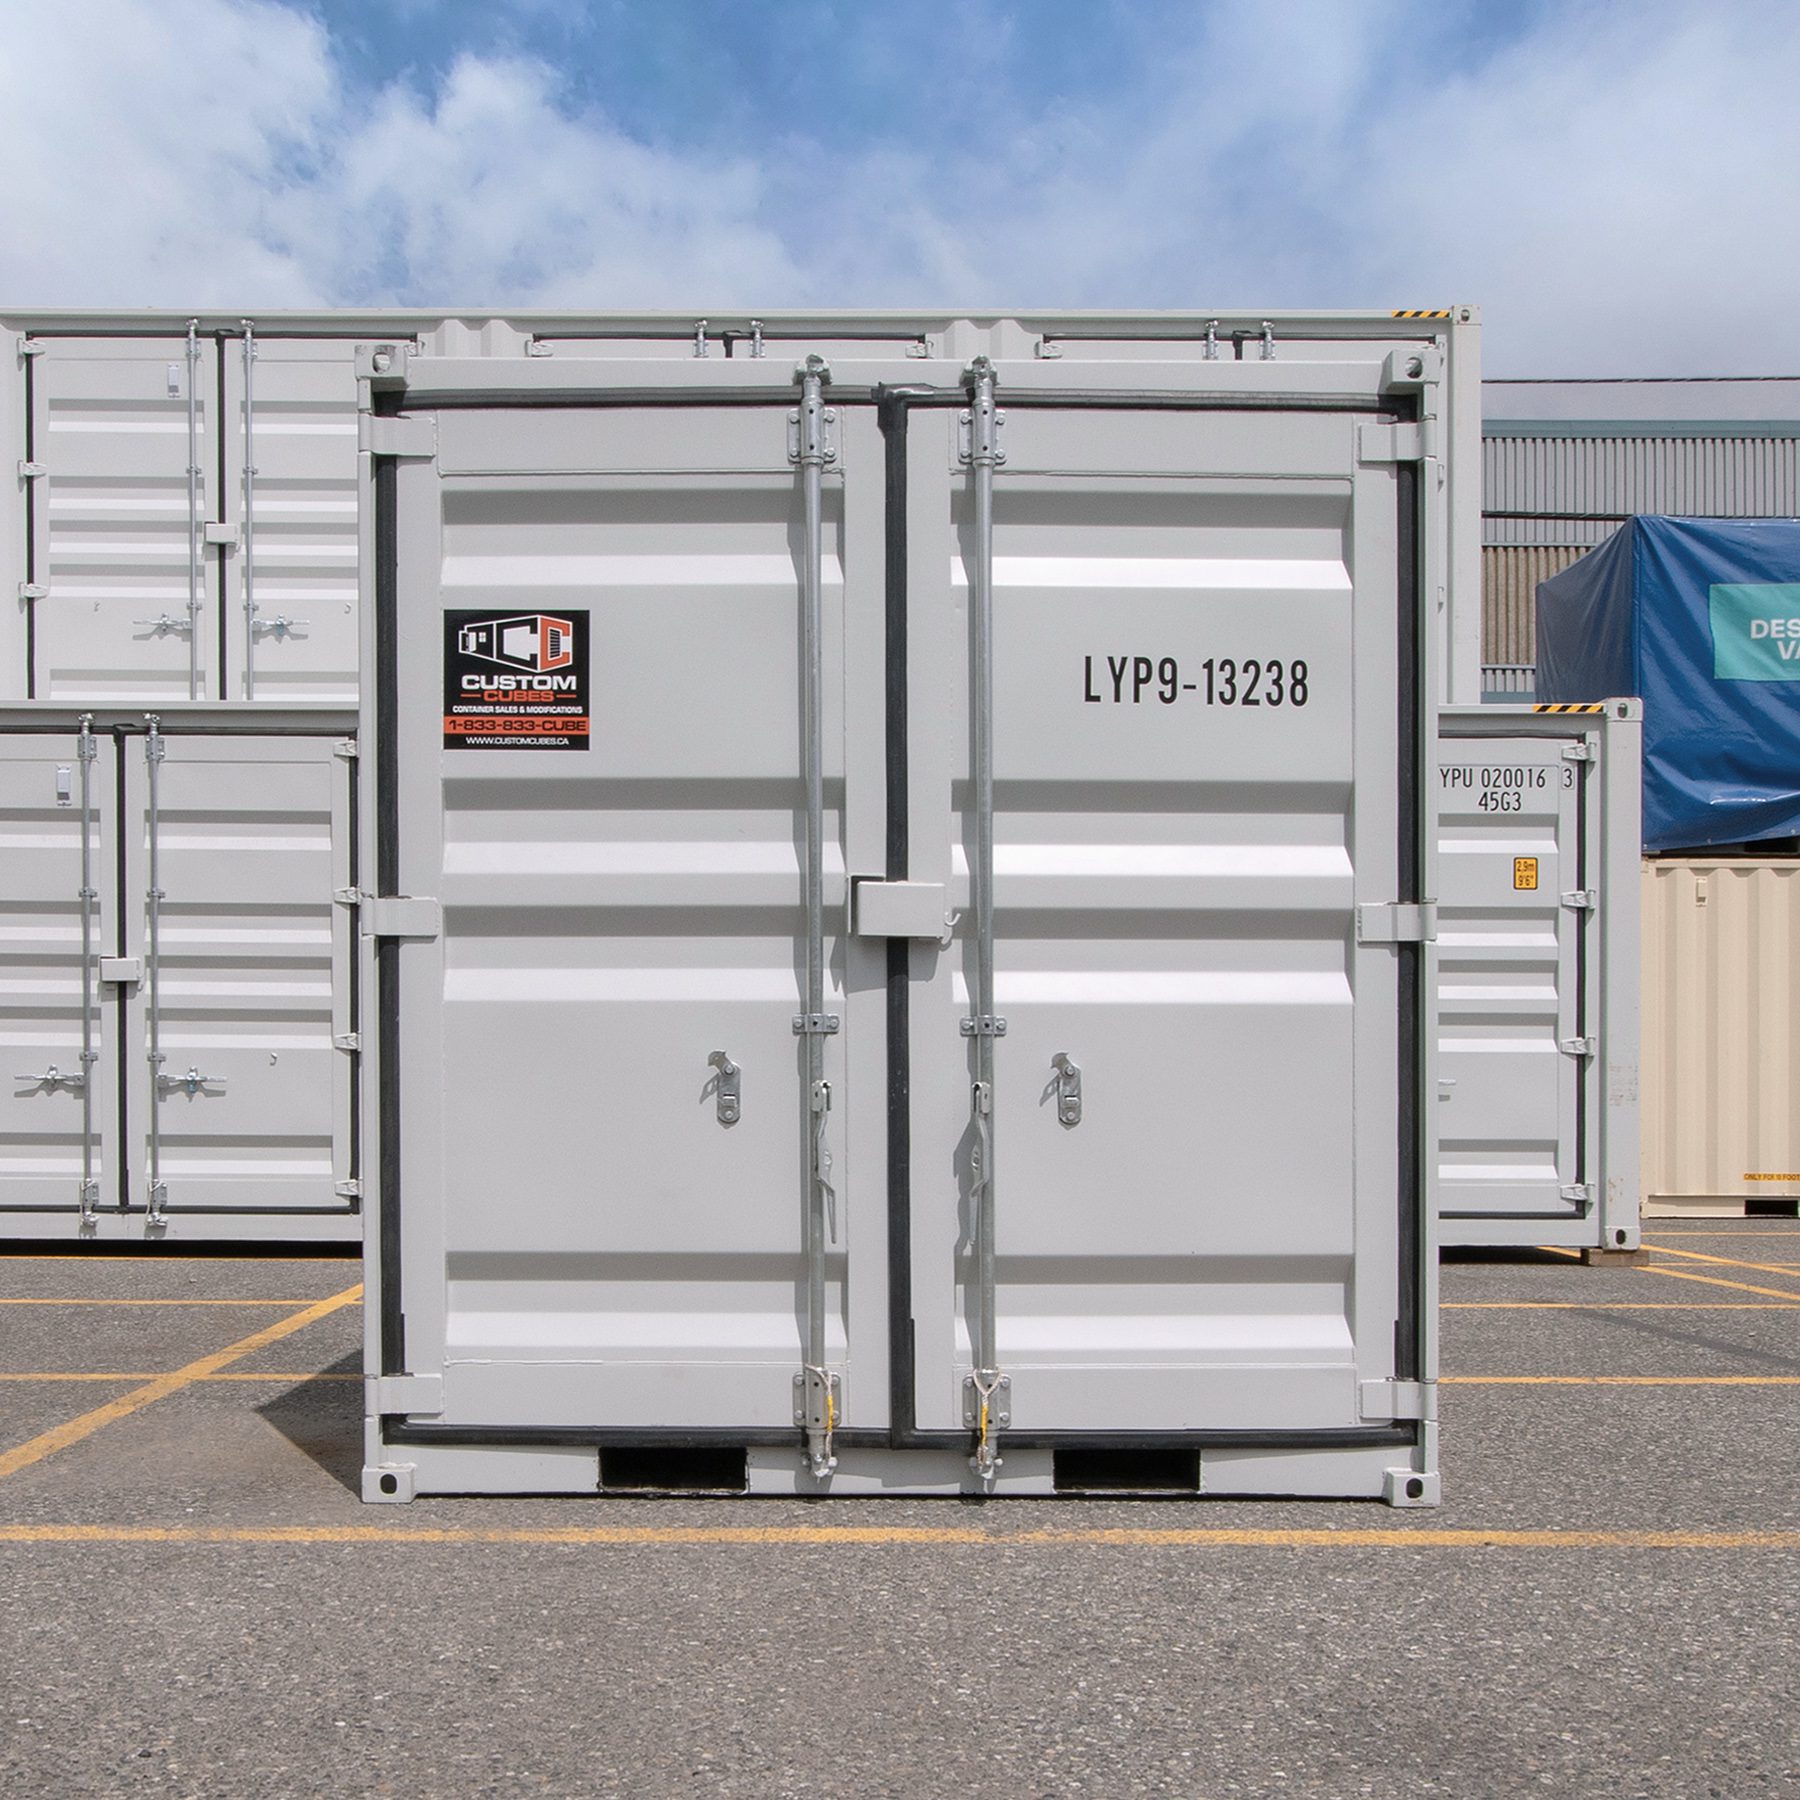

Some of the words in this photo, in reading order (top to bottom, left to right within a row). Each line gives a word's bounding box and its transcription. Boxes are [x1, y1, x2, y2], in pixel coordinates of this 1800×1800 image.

[461, 675, 577, 690] CUSTOM
[1085, 656, 1309, 706] LYP9-13238
[483, 690, 555, 702] CUBES
[452, 705, 494, 713] CONTAINER
[495, 705, 518, 713] SALES
[526, 706, 583, 714] MODIFICATIONS
[449, 720, 586, 731] 1-833-833-CUBE
[465, 736, 570, 745] WWW.CUSTOMCUBES.CA
[1481, 768, 1546, 788] 020016
[1563, 768, 1573, 788] 3
[1478, 792, 1521, 811] 45G3
